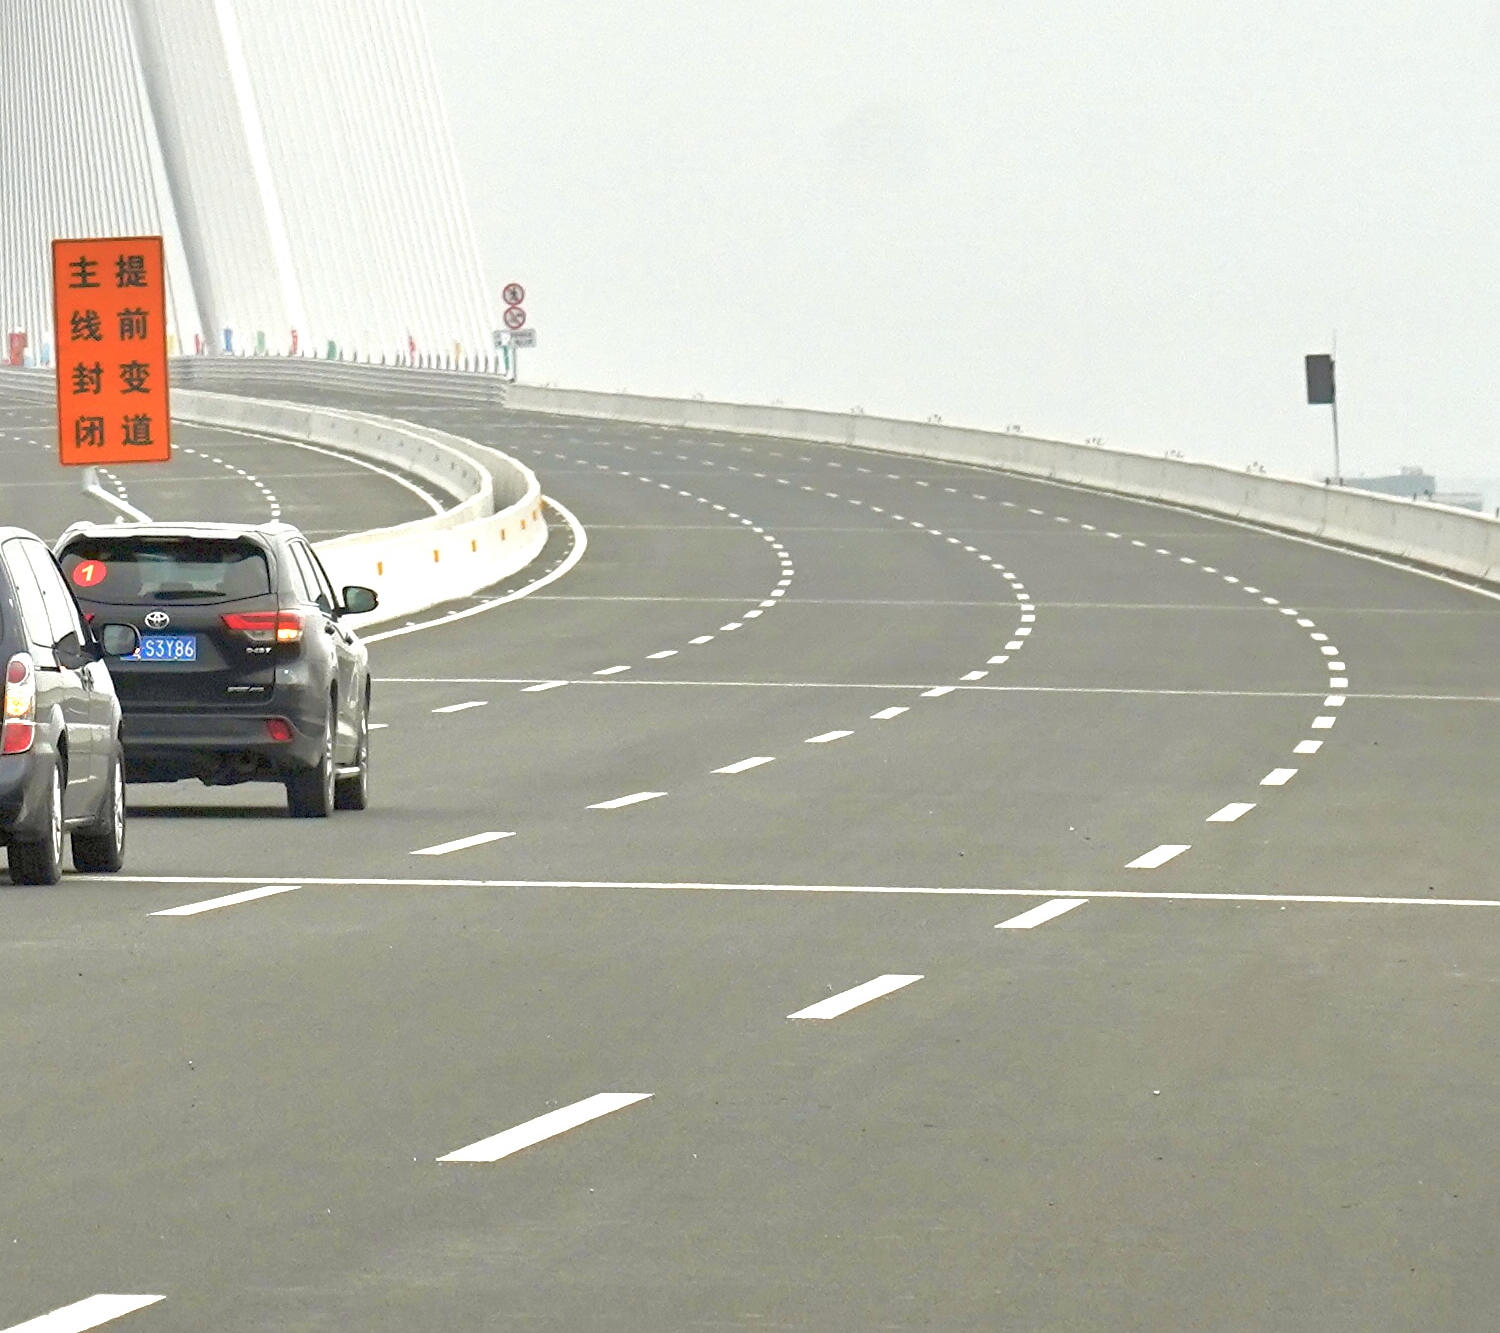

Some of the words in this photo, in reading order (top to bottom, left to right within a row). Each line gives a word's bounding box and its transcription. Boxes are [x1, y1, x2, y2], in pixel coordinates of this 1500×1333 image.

[68, 254, 105, 449] 主线封闭
[114, 254, 154, 447] 提前变道
[81, 564, 95, 582] 1
